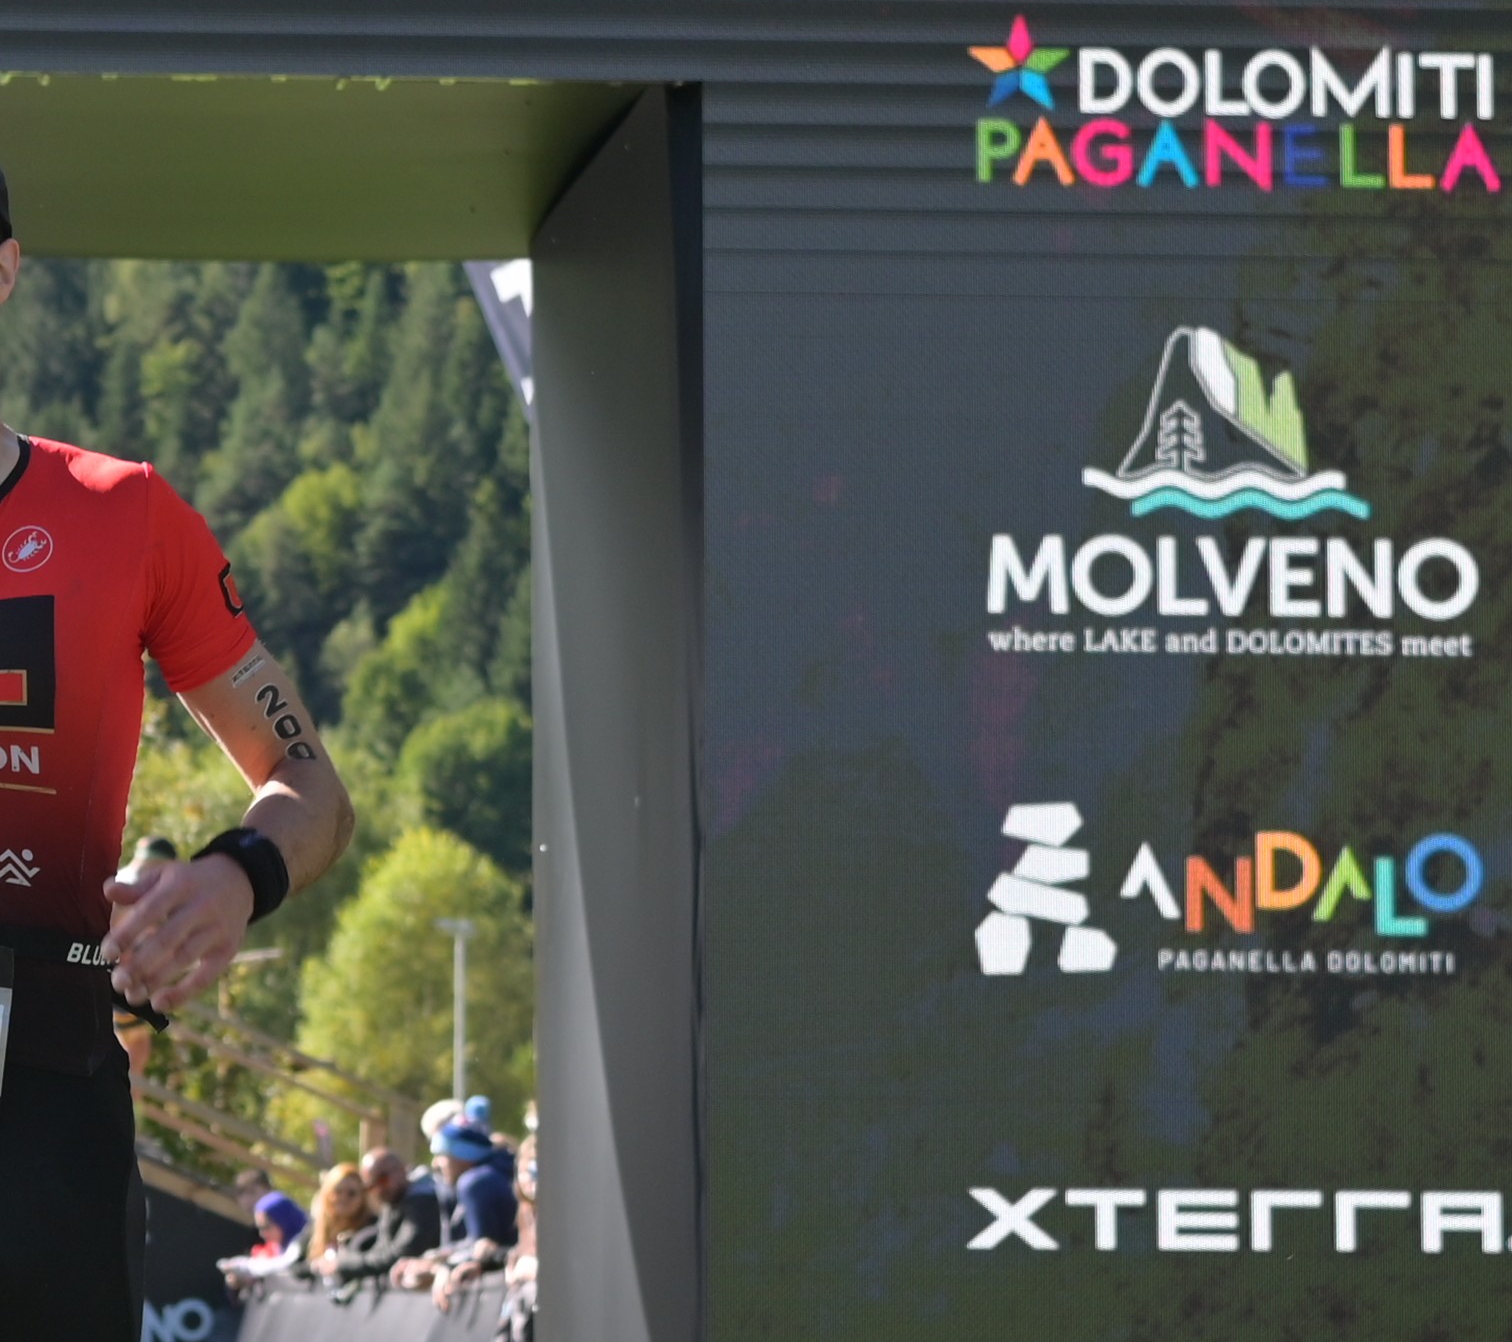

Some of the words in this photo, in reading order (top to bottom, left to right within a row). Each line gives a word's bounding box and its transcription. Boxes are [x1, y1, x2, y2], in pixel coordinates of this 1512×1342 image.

[1078, 47, 1493, 120] DOLOMITI
[976, 118, 1501, 192] PAGANELLA
[987, 534, 1479, 621] MOLVENO
[987, 626, 1075, 653] where
[1083, 628, 1156, 653] LAKE
[1164, 628, 1217, 654] and
[1225, 629, 1393, 656] DOLOMITES
[1400, 632, 1472, 657] meet
[1120, 831, 1483, 937] ANDALO
[1157, 949, 1316, 973] PAGANELLA
[1326, 950, 1455, 975] DOLOMITI
